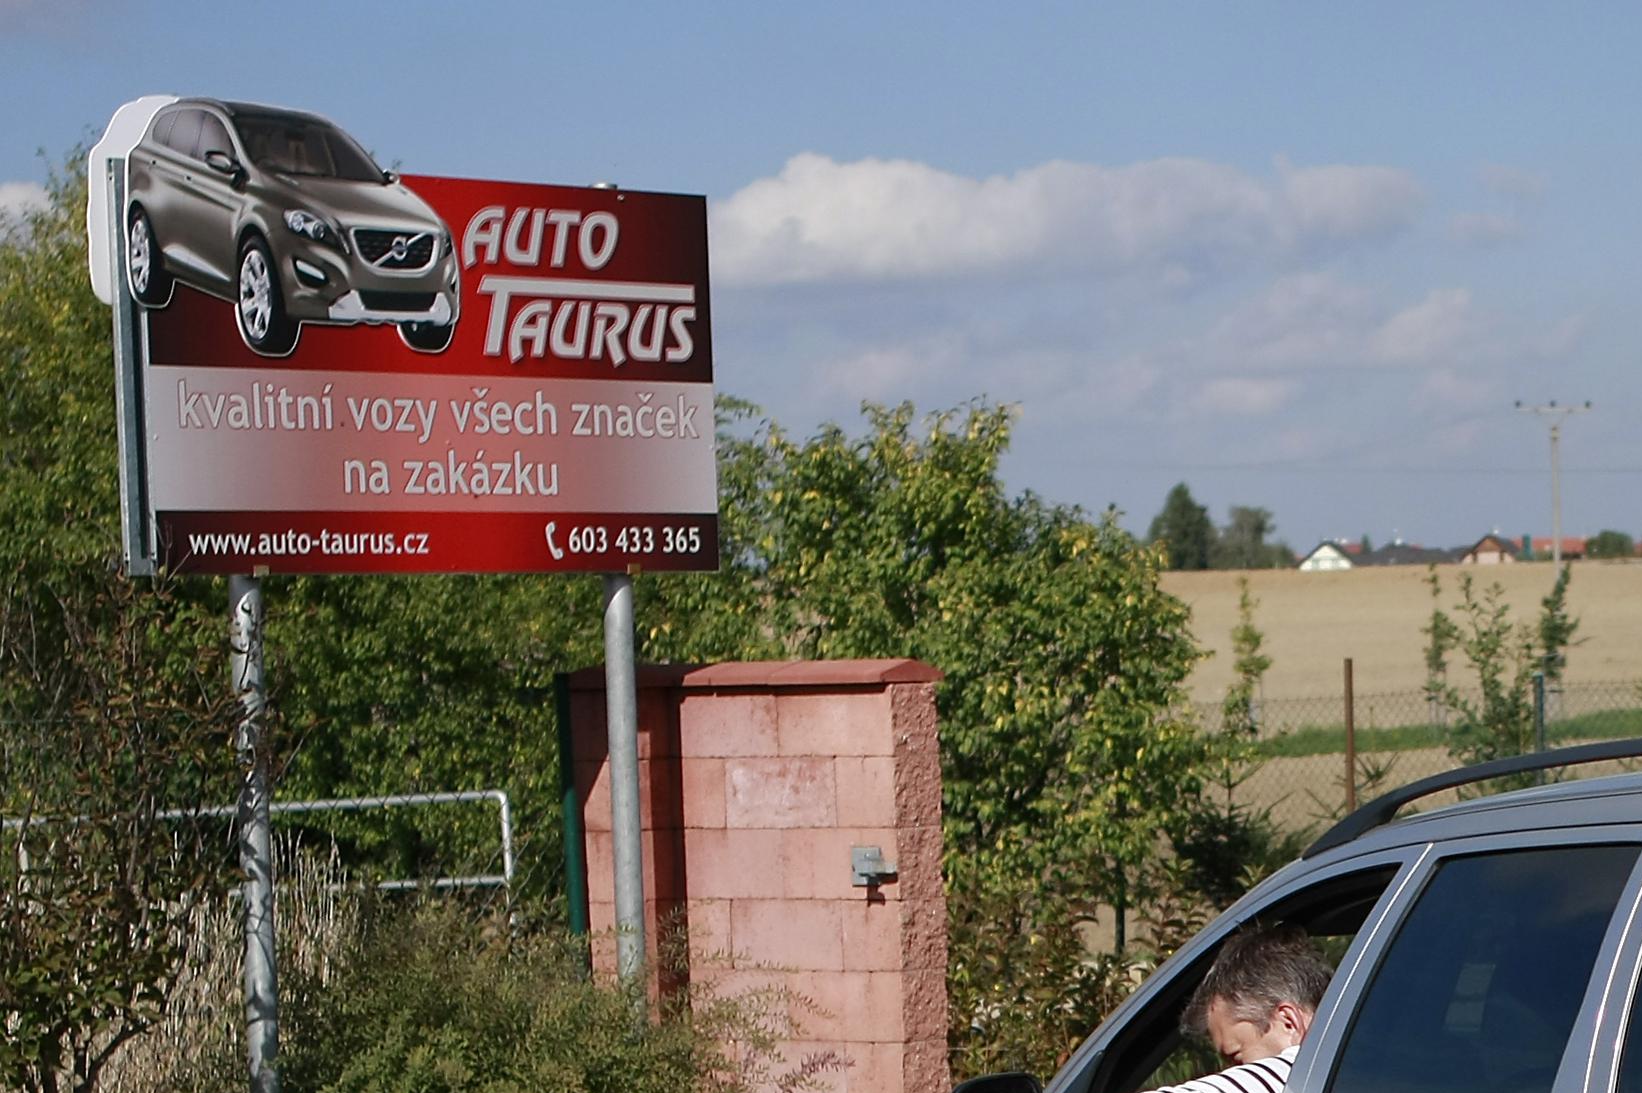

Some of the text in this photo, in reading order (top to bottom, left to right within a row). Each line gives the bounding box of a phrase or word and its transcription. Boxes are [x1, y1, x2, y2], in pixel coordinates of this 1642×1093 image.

[462, 206, 620, 271] AUTO
[476, 274, 697, 368] TAURUS
[178, 380, 700, 443] kvalitní vozy všech značek
[344, 450, 559, 497] na zakázku
[188, 526, 429, 556] www.auto-taurus.cz
[568, 526, 701, 553] 603 433 365
